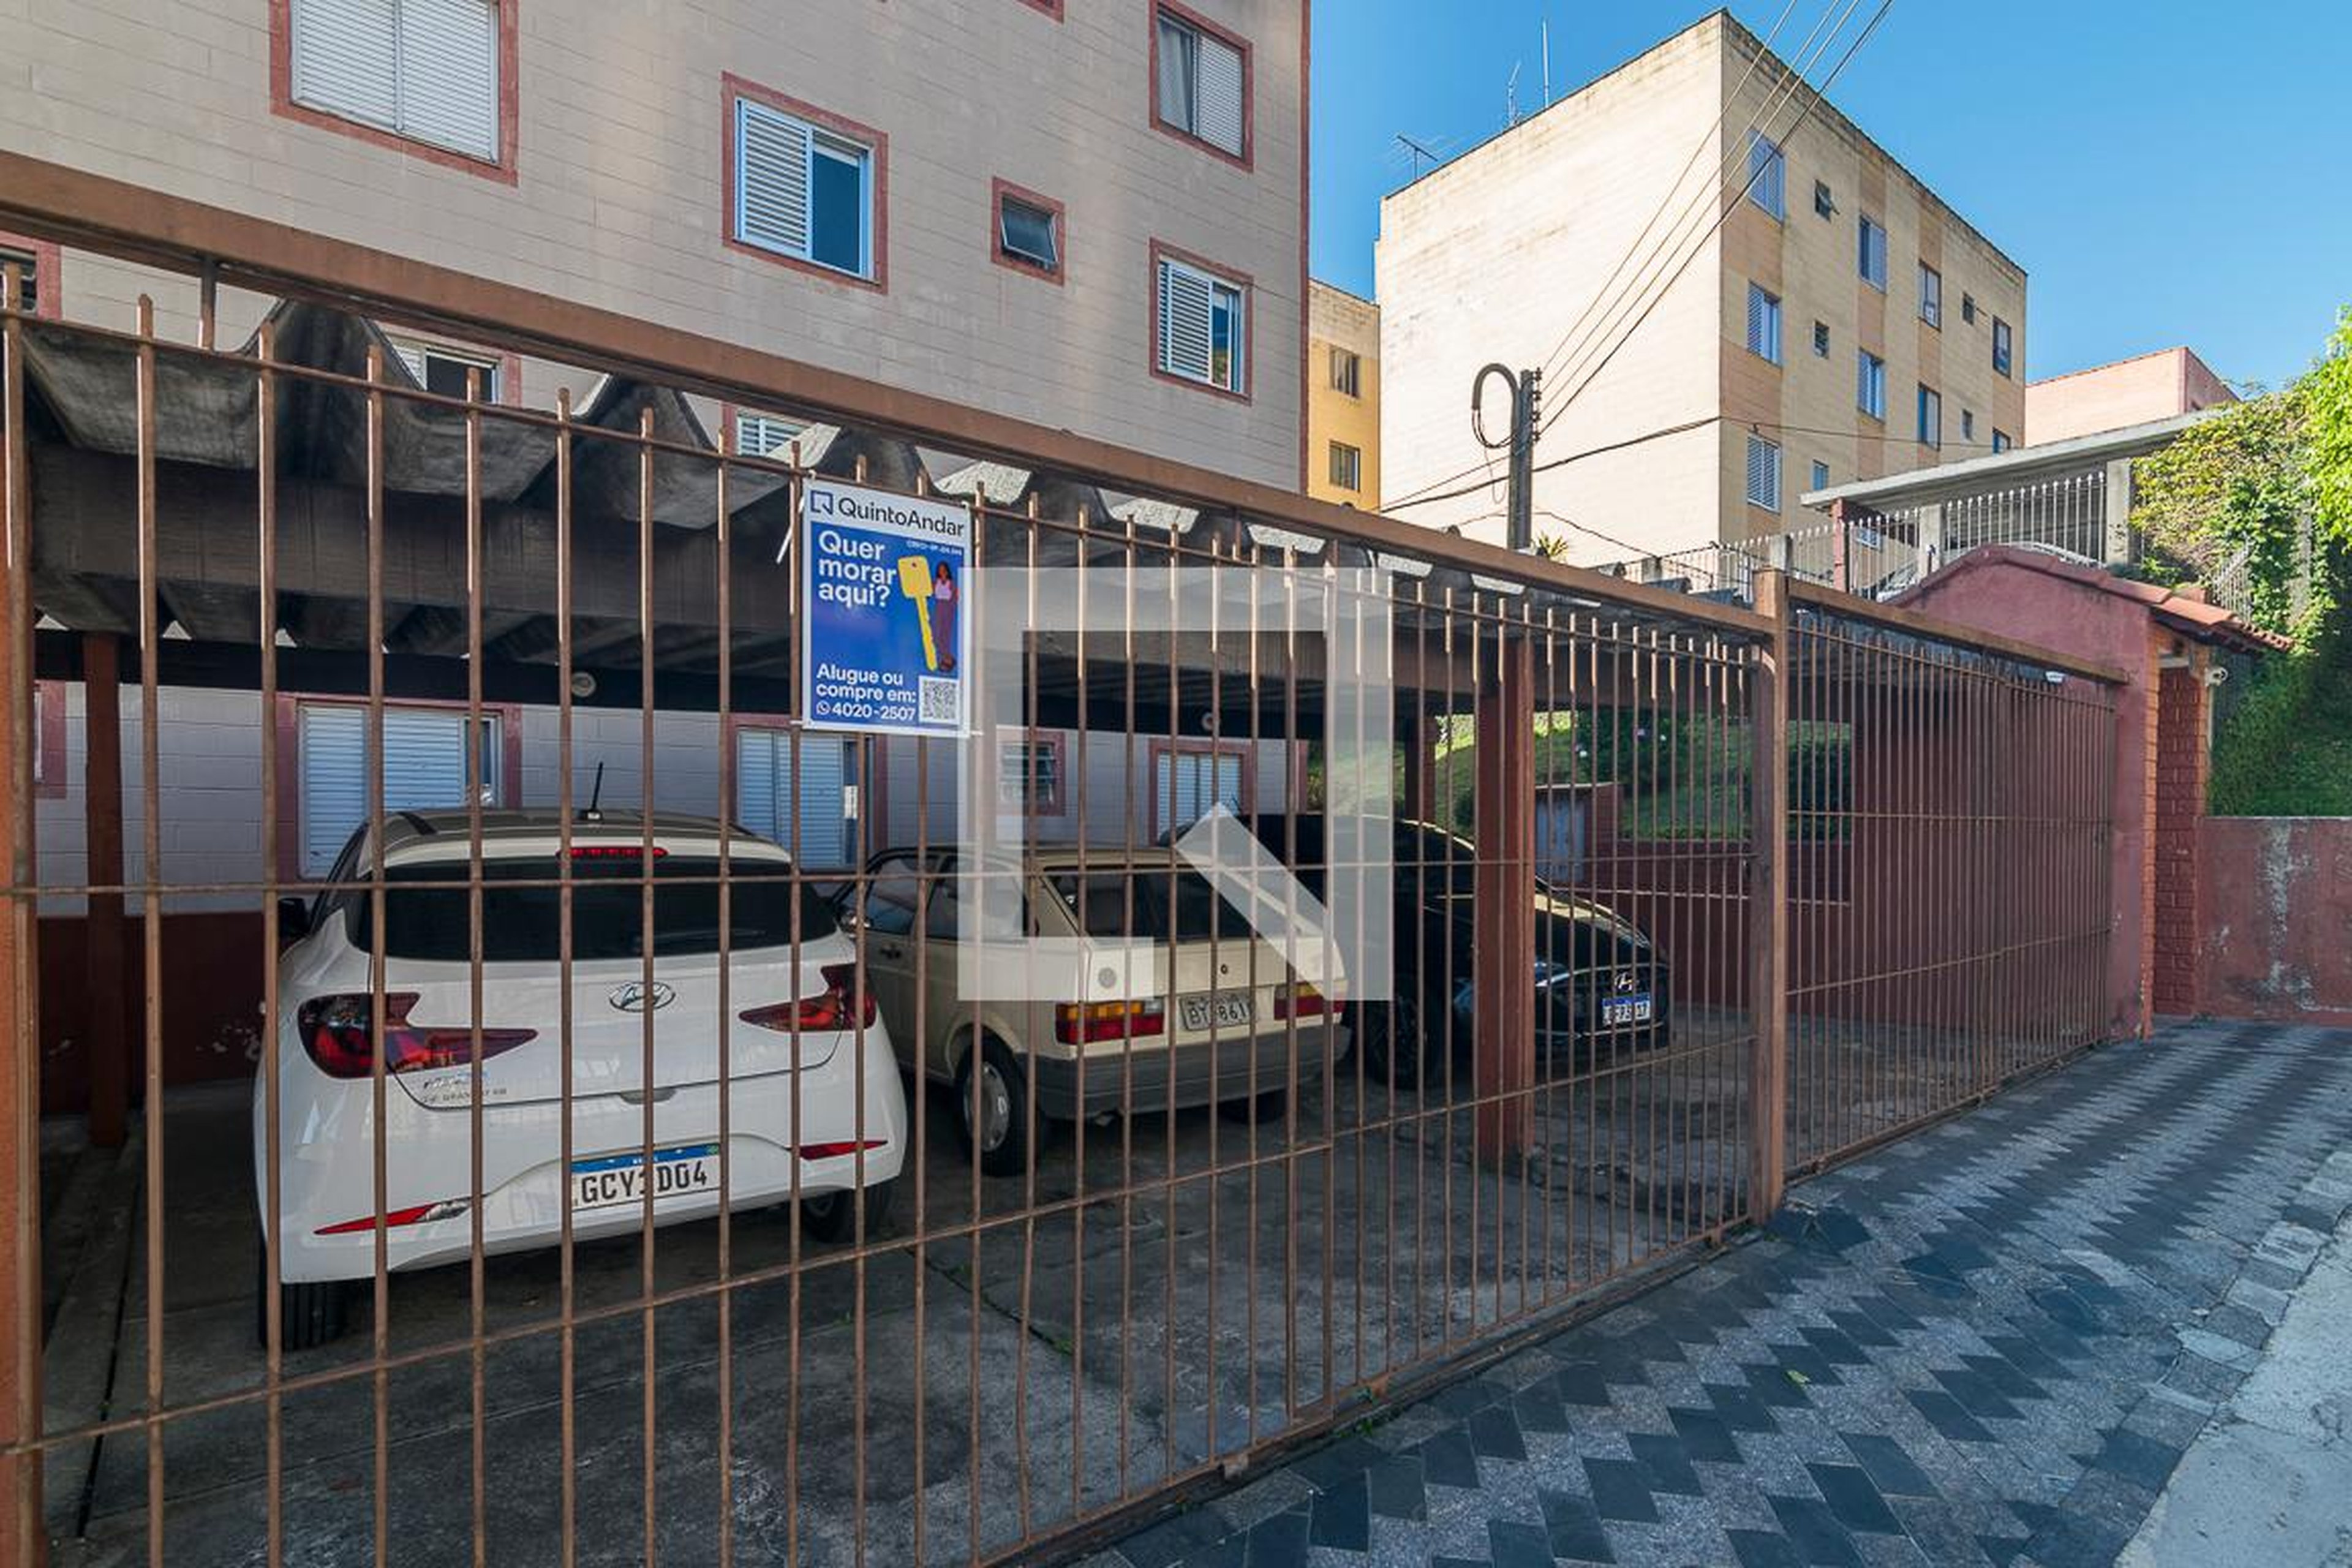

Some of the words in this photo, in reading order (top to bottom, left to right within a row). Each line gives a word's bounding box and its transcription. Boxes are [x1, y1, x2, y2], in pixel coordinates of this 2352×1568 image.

[839, 497, 964, 537] QuintoAndar
[820, 531, 885, 560] Quer
[820, 559, 896, 584] morar
[820, 583, 891, 608] aqui?
[816, 663, 880, 685] Alugue
[883, 673, 903, 685] ou
[816, 684, 883, 702] compre
[886, 690, 916, 703] em:
[832, 703, 915, 720] 4020-2507
